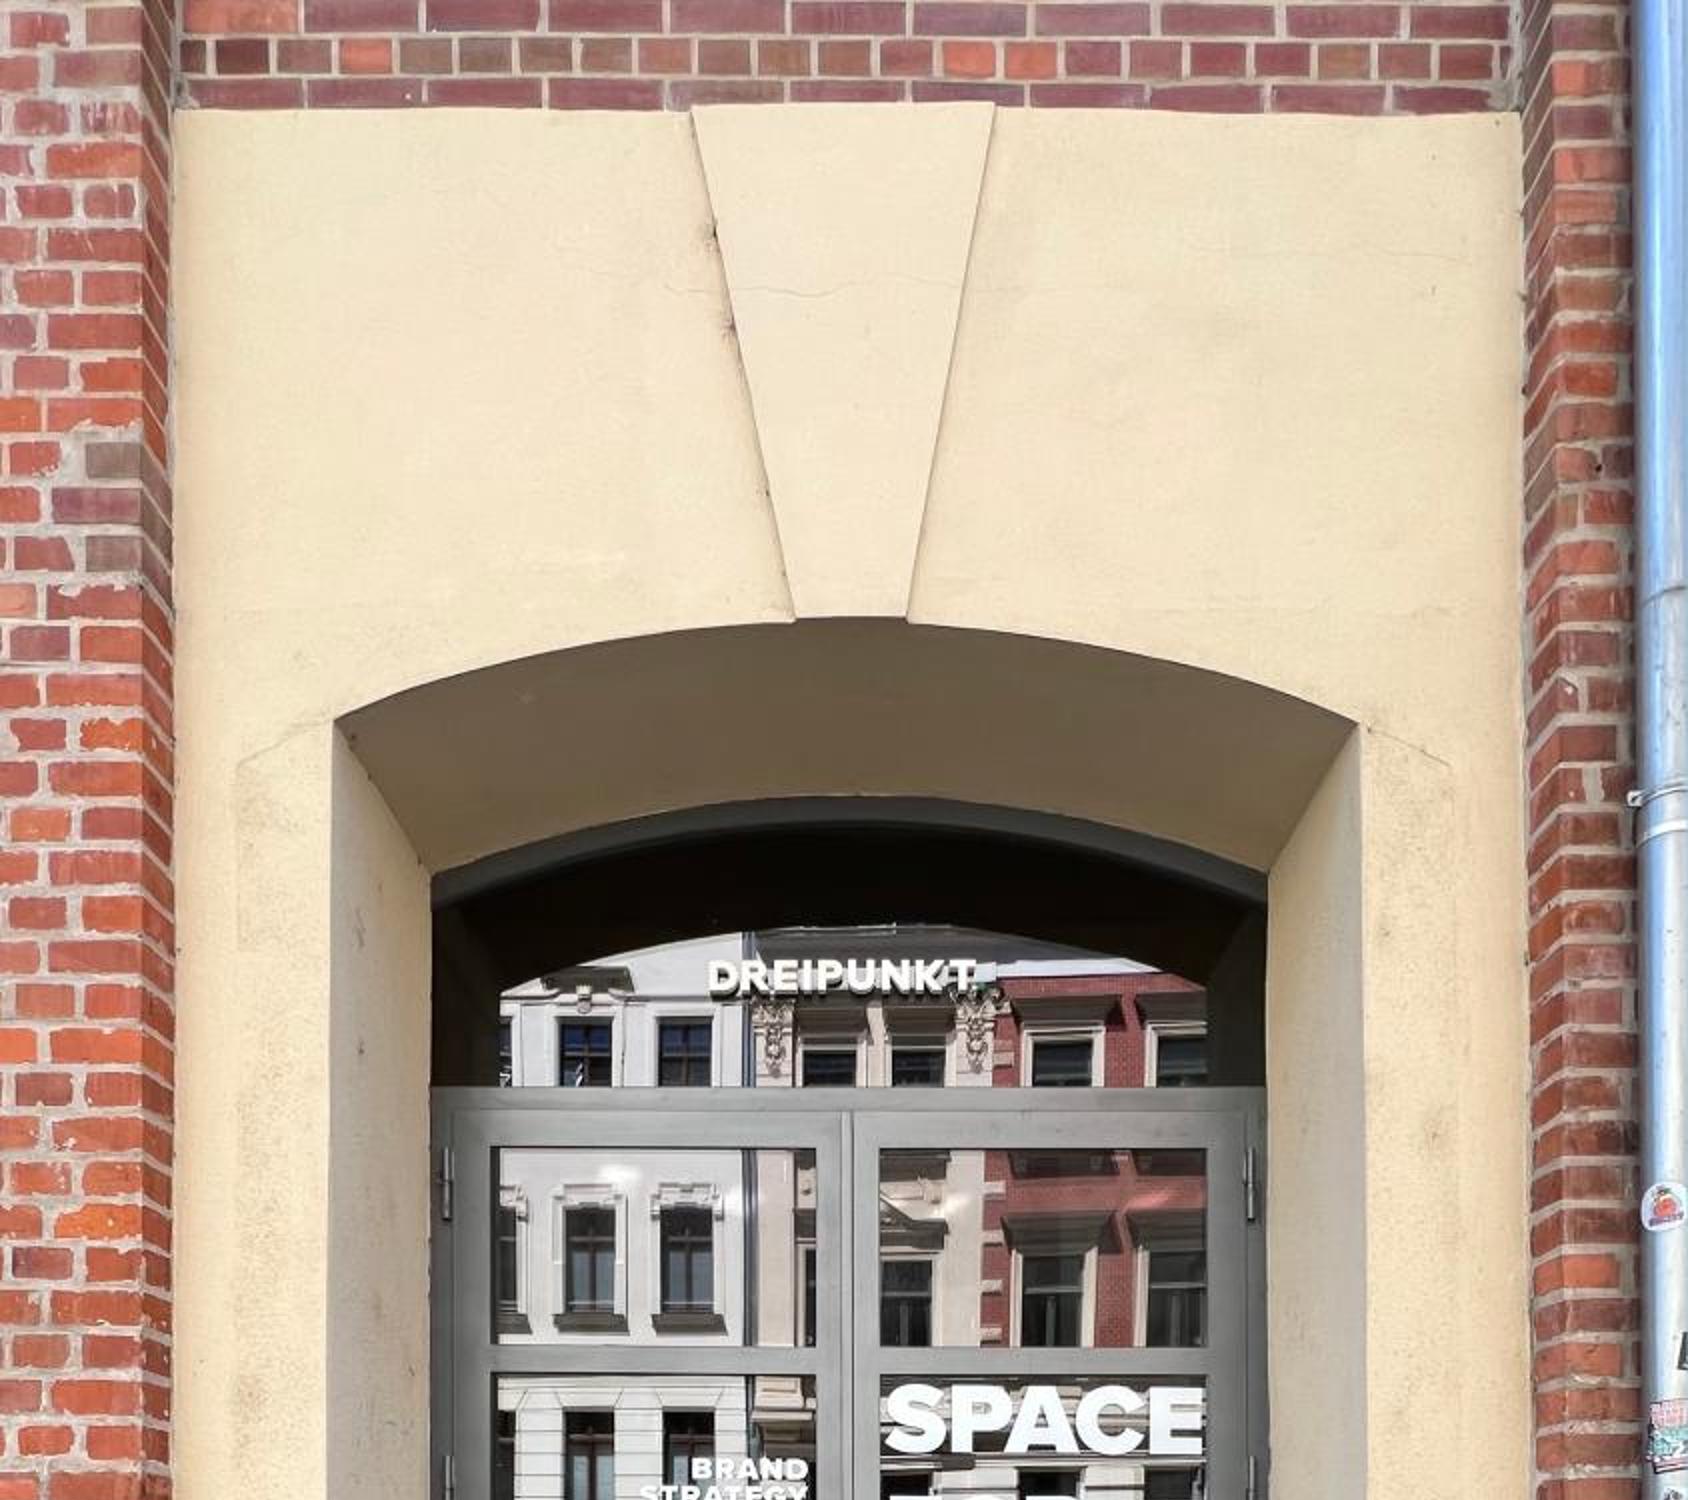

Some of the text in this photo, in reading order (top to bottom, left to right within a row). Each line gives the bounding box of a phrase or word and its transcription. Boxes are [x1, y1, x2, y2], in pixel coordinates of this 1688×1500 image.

[707, 958, 978, 996] DREIPUNKT
[885, 1384, 1203, 1455] SPACE
[690, 1457, 809, 1482] BRAND
